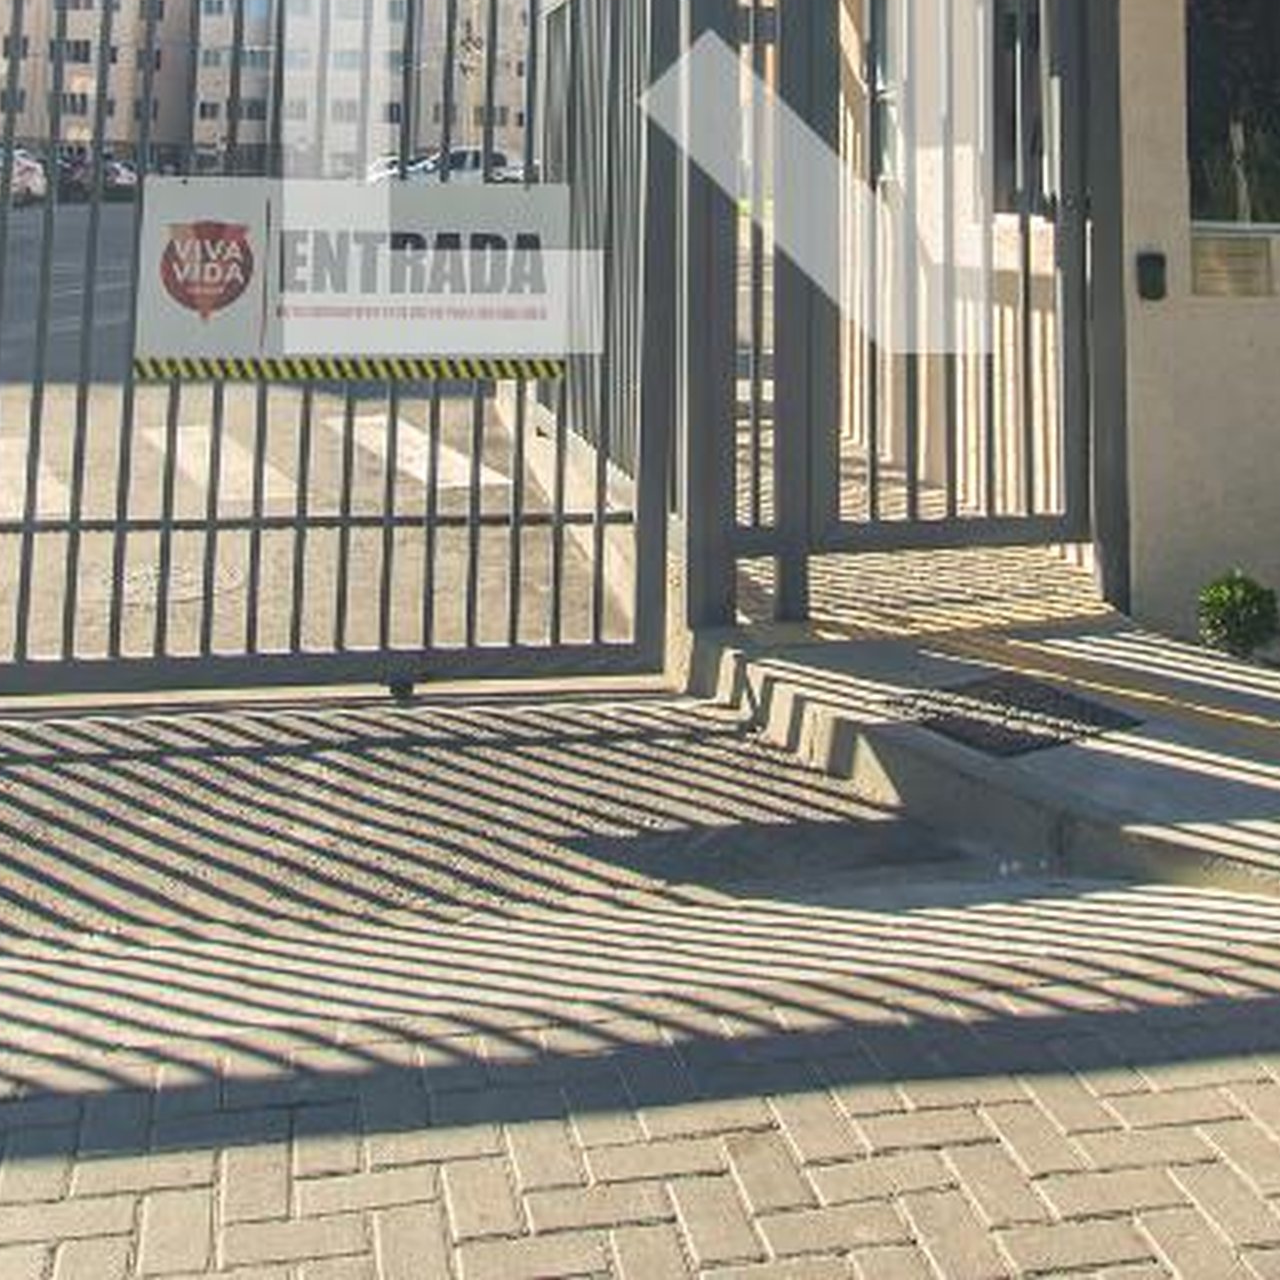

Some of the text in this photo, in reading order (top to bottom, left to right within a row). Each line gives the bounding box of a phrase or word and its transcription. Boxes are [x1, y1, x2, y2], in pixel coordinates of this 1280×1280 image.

[173, 239, 245, 261] VIVA
[172, 261, 245, 284] VIDA
[279, 230, 547, 294] ENTRADA
